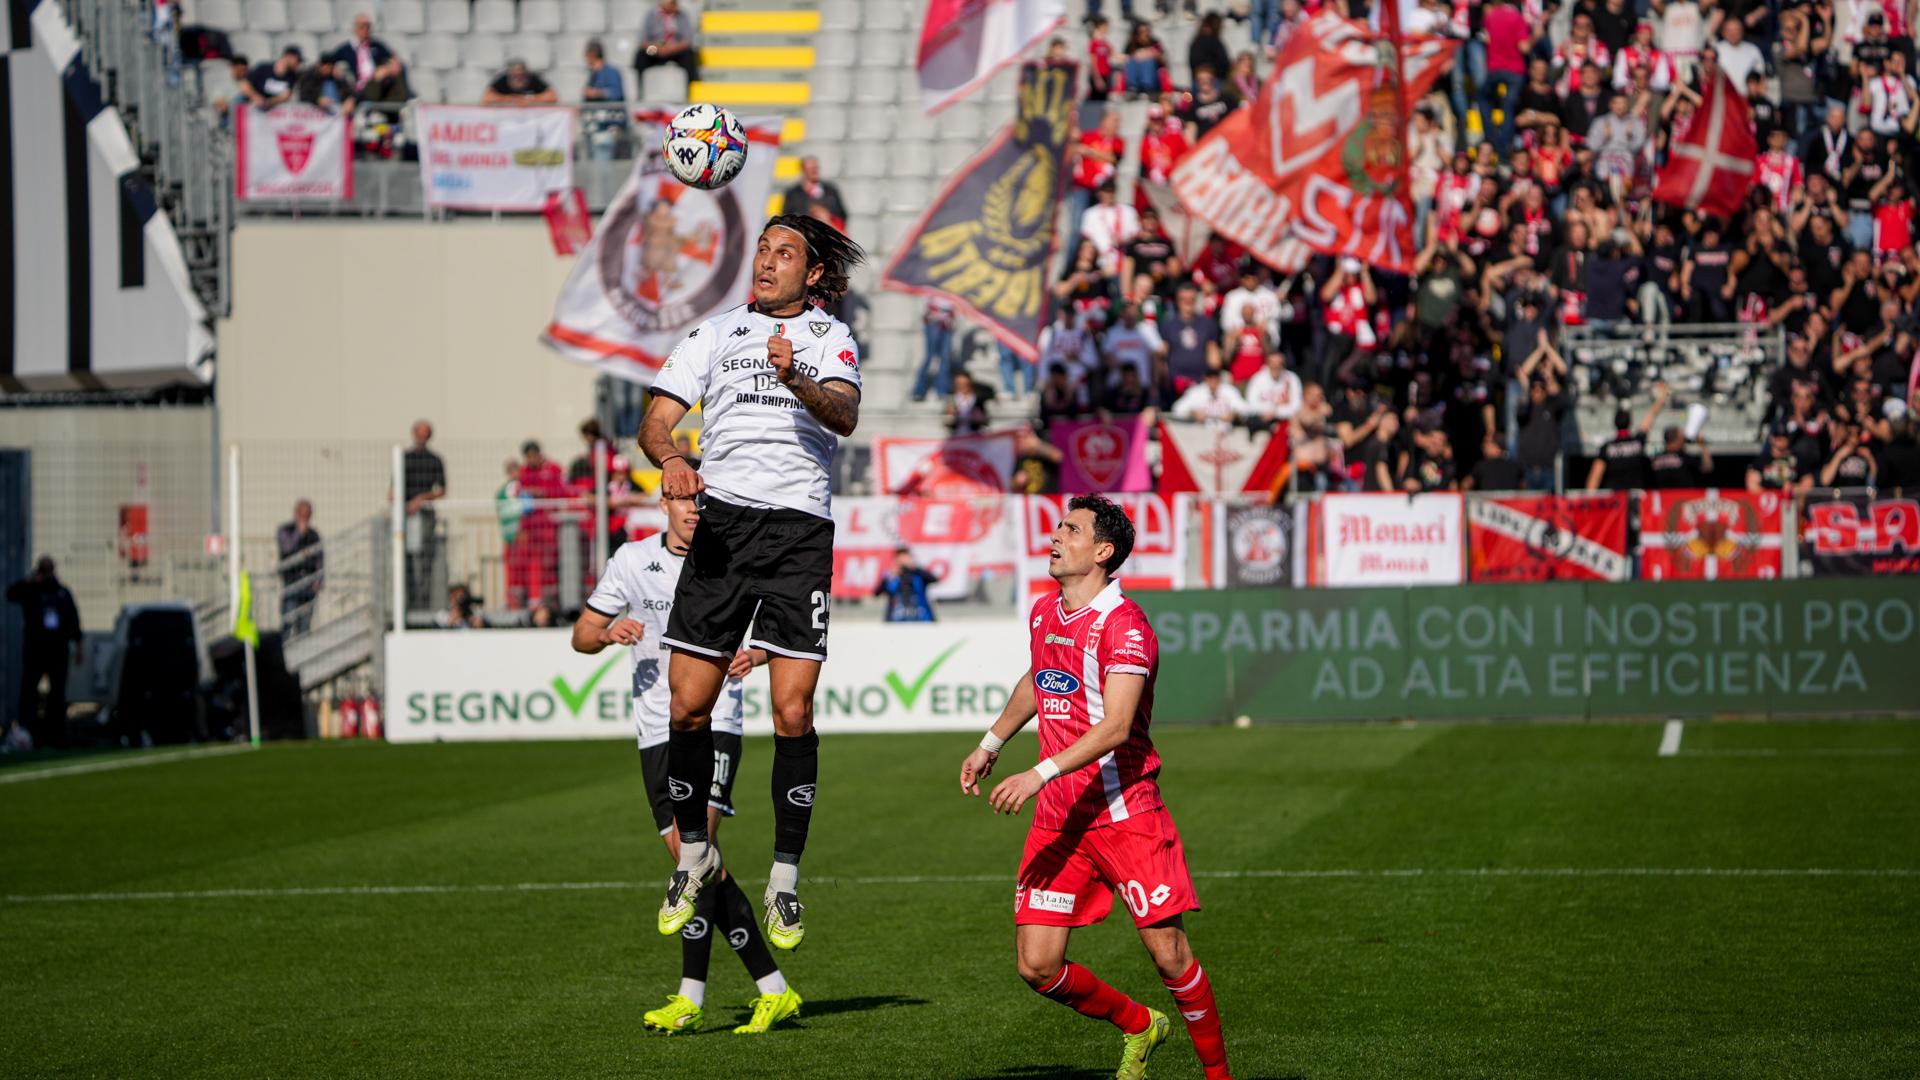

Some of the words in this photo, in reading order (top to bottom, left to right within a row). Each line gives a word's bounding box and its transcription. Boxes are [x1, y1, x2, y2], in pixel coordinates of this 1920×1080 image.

[429, 122, 496, 144] AMICI
[736, 392, 760, 404] DANI
[761, 395, 805, 410] SHIPPIN
[1338, 514, 1447, 549] Monaci
[811, 590, 830, 630] 2
[1156, 606, 1400, 653] SPARMIA
[1416, 604, 1535, 649] CON
[1553, 604, 1564, 646] I
[1584, 602, 1783, 647] NOSTRI
[1041, 671, 1070, 692] Ford
[1312, 656, 1386, 700] AD
[1402, 654, 1531, 699] ALTA
[1548, 651, 1868, 696] EFFICIENZA
[1043, 698, 1071, 713] PRO
[1045, 894, 1057, 903] La
